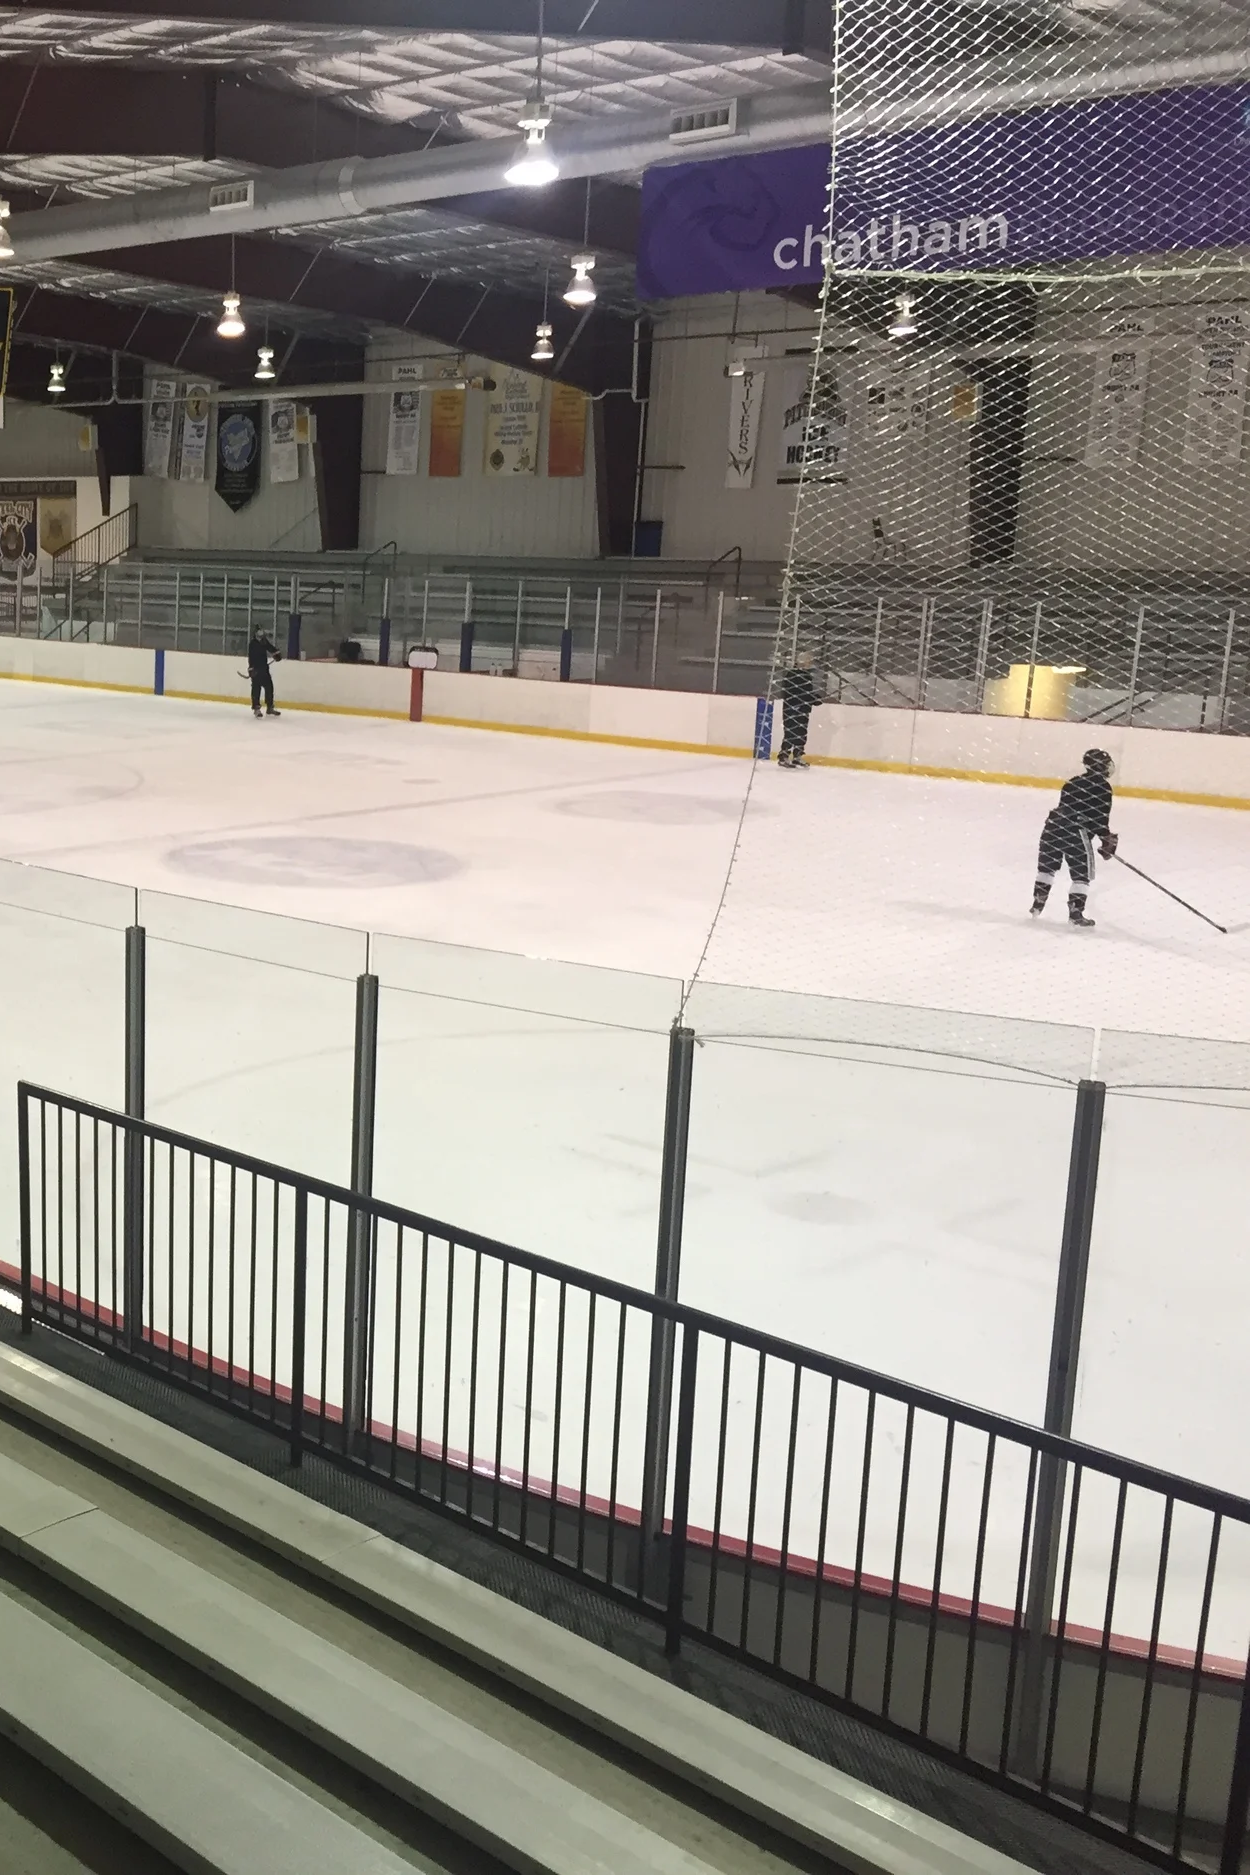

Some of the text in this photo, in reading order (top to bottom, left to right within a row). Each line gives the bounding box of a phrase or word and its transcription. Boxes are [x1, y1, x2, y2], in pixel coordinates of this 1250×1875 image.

[773, 213, 1009, 271] chatham
[1206, 316, 1242, 325] PAHL
[397, 367, 417, 375] PAHL
[739, 371, 754, 454] RIVERS
[15, 501, 34, 523] CITY
